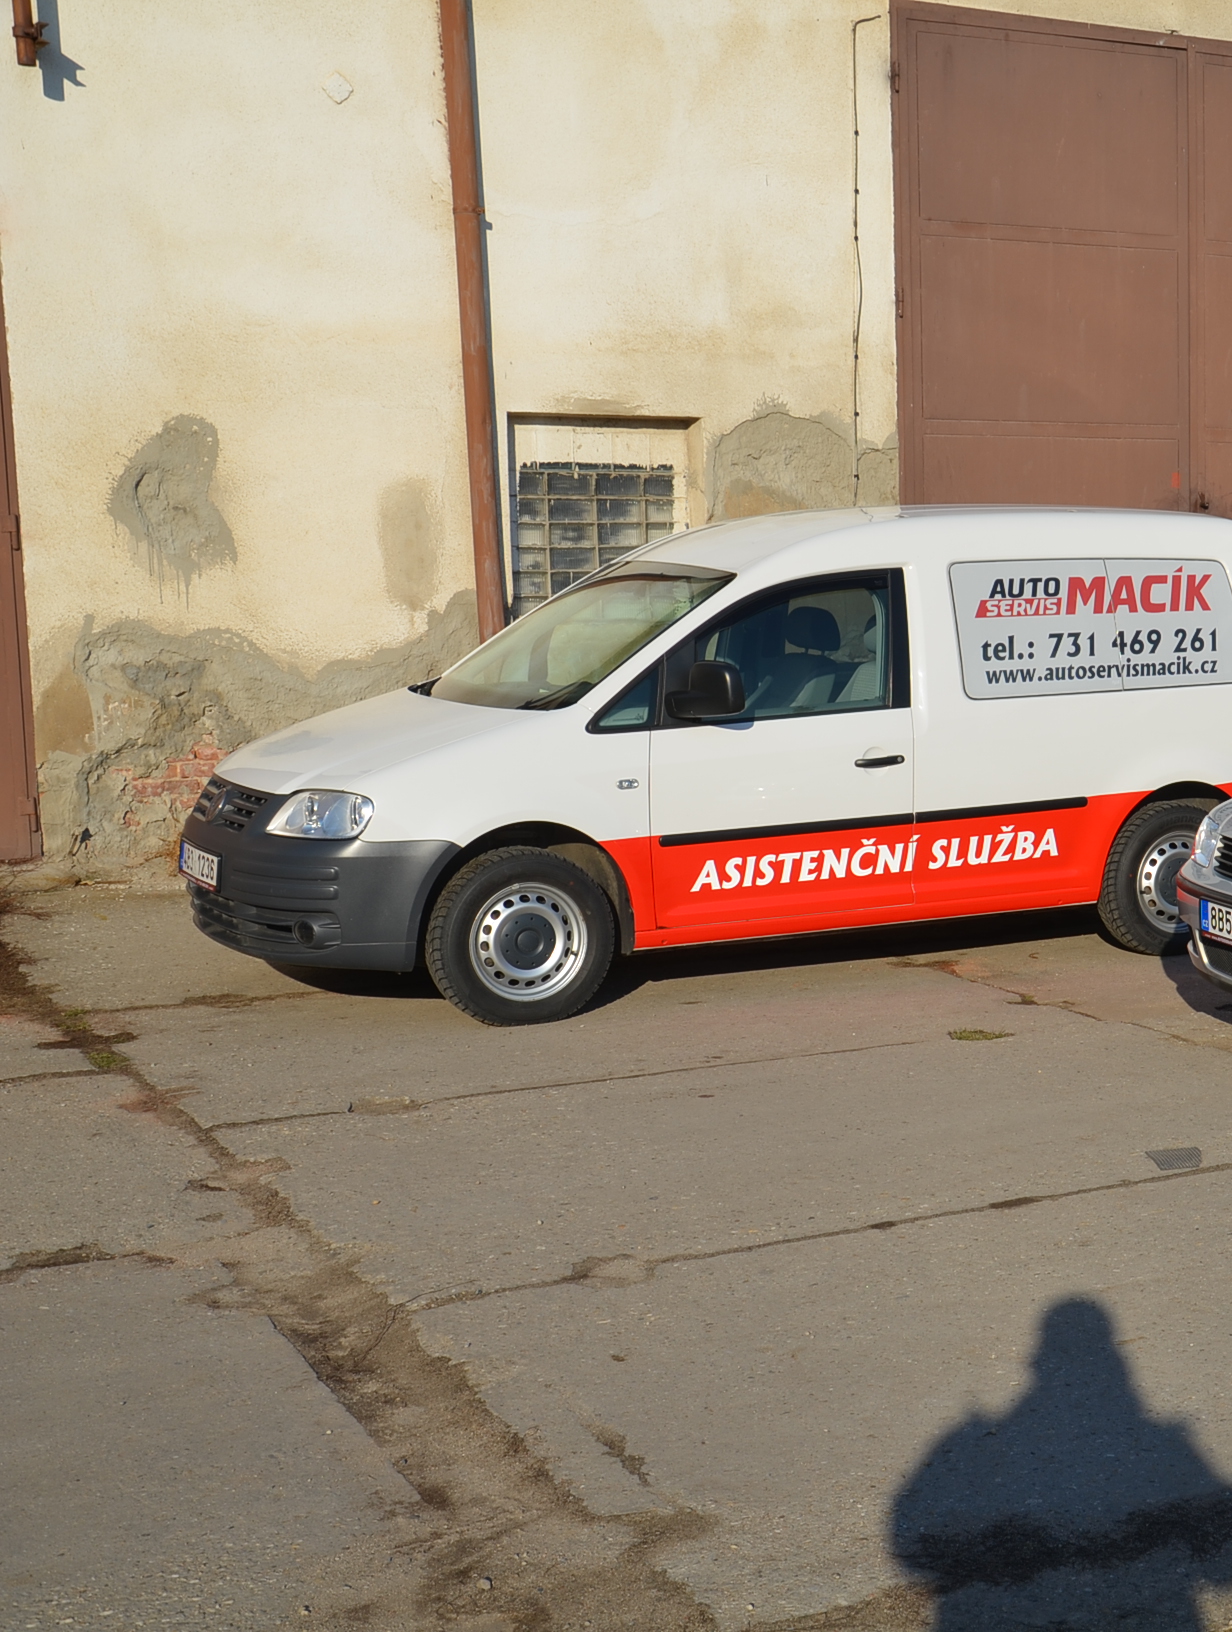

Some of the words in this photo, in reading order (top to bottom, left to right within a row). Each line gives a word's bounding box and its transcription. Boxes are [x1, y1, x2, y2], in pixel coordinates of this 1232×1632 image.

[989, 577, 1061, 598] AUTO
[1065, 565, 1212, 615] MACÍK
[986, 598, 1058, 617] SERVIS
[981, 635, 1035, 662] tel.:
[1048, 632, 1096, 658] 731
[1111, 629, 1162, 656] 469
[1173, 627, 1218, 652] 261
[985, 655, 1218, 685] www.autoservismacik.cz
[690, 834, 921, 892] ASISTENČNÍ
[928, 824, 1059, 869] SLUŽBA
[1210, 906, 1232, 935] 8B5
